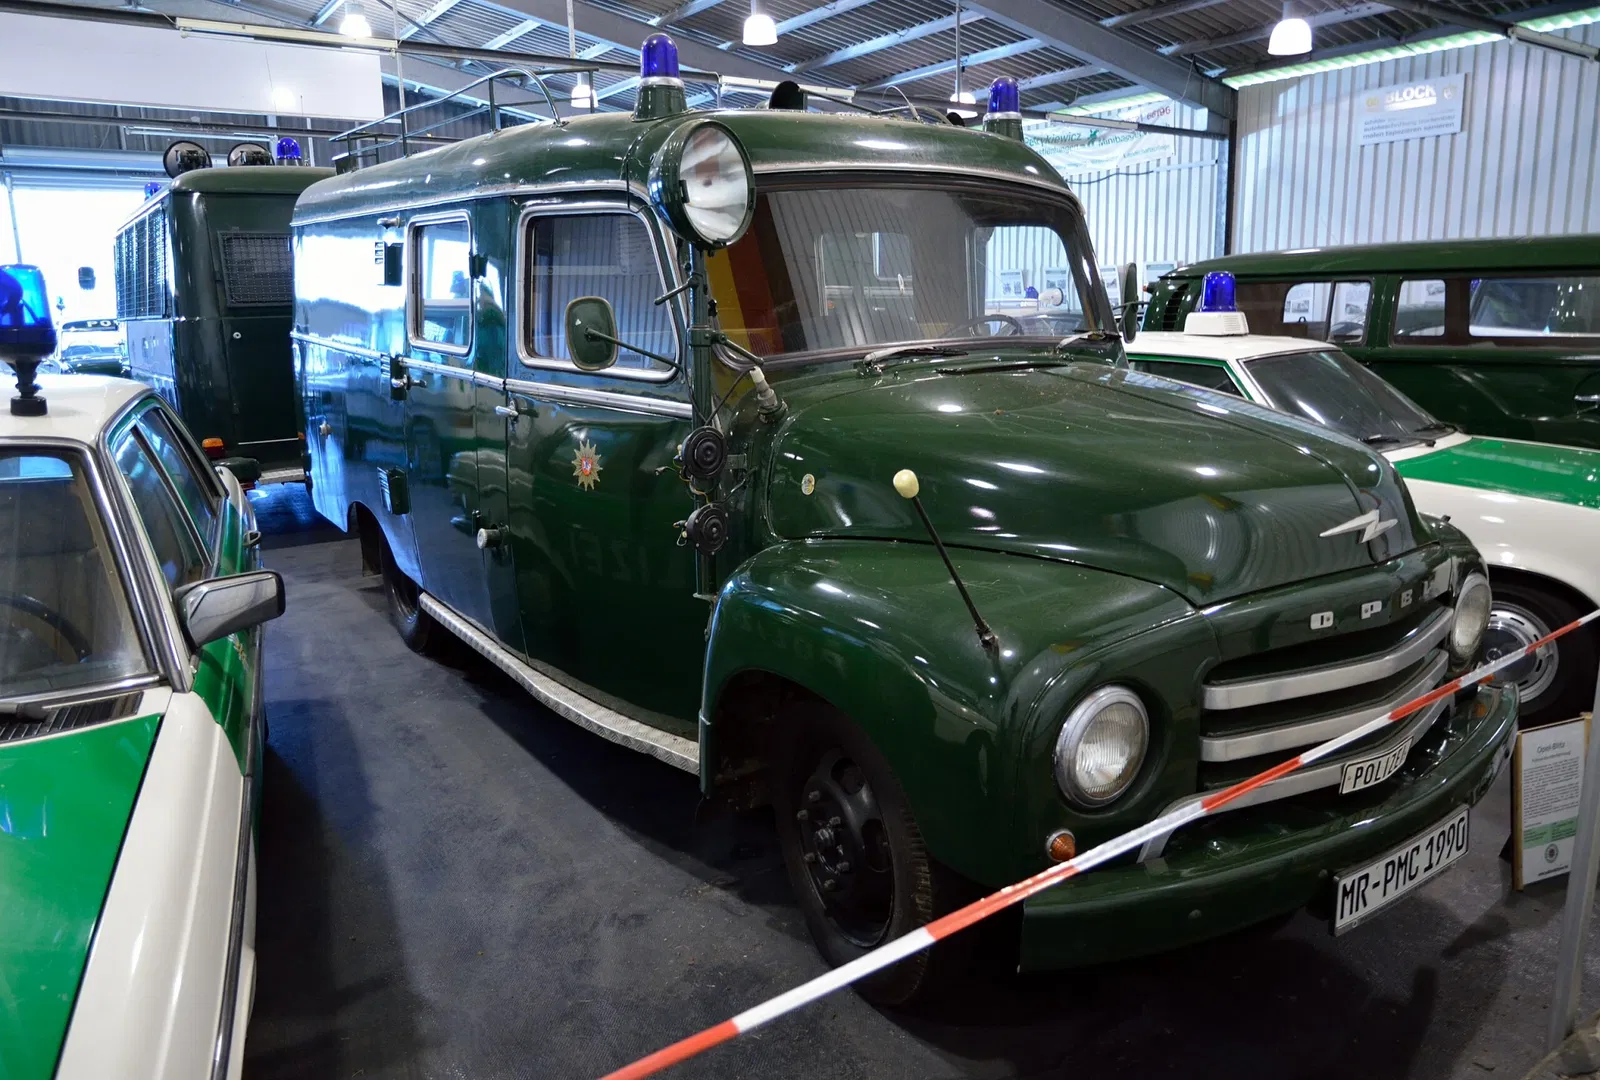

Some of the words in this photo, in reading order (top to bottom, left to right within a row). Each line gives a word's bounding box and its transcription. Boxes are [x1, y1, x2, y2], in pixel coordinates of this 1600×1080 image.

[1384, 84, 1437, 103] BLOCK
[1352, 746, 1408, 789] POLIZEI
[1340, 845, 1420, 920] MR-PMC
[1424, 816, 1466, 874] 1990
